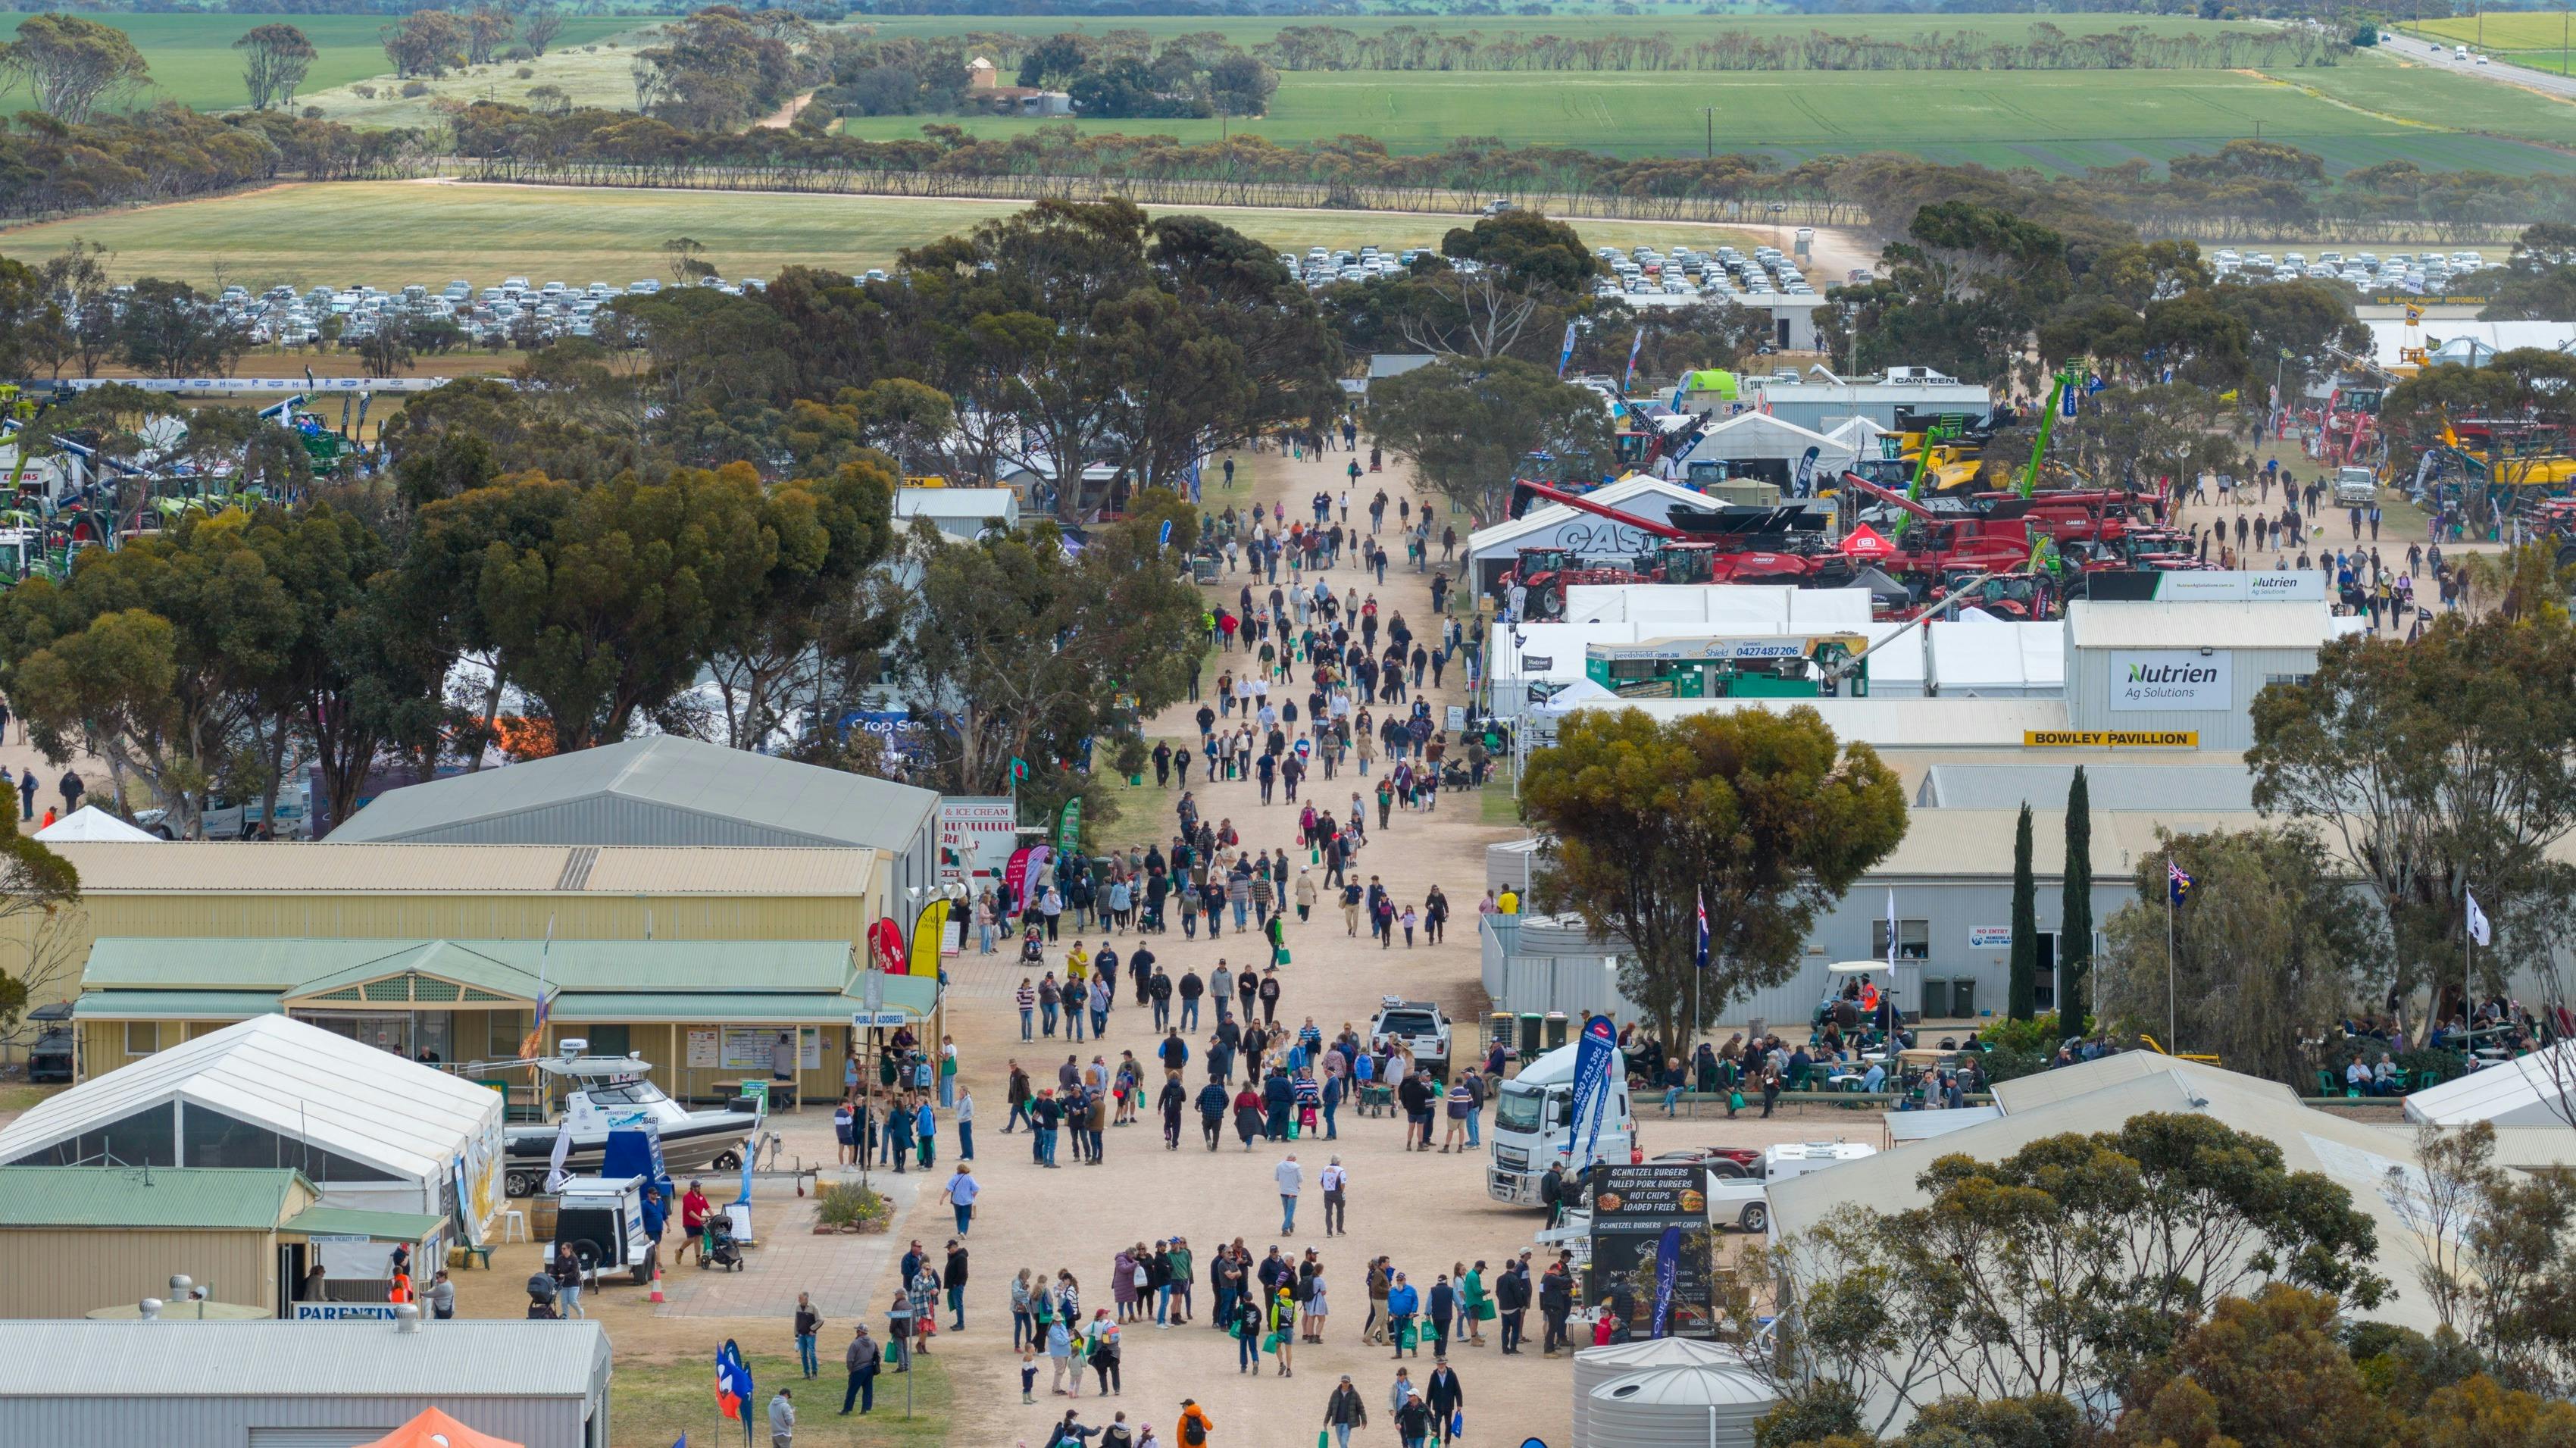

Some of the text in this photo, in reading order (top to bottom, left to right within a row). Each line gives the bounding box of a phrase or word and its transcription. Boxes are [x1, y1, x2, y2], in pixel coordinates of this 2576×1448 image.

[1555, 523, 1655, 553] CAS
[2252, 576, 2297, 587] Nutrien
[1615, 651, 1680, 659] seedshield.com.au
[2127, 662, 2218, 683] Nutrien
[2125, 687, 2194, 700] Ag Solutions
[852, 719, 946, 733] Crop Smt
[2035, 733, 2187, 744] BOWLEY PAVILLION
[855, 1015, 903, 1024] PUBLI ADDRESS
[1573, 1046, 1602, 1105] 1300 755 395
[1588, 1049, 1610, 1093] SOLUTIONS
[1608, 1180, 1634, 1188] PULLED
[299, 1307, 395, 1320] PARENTIN
